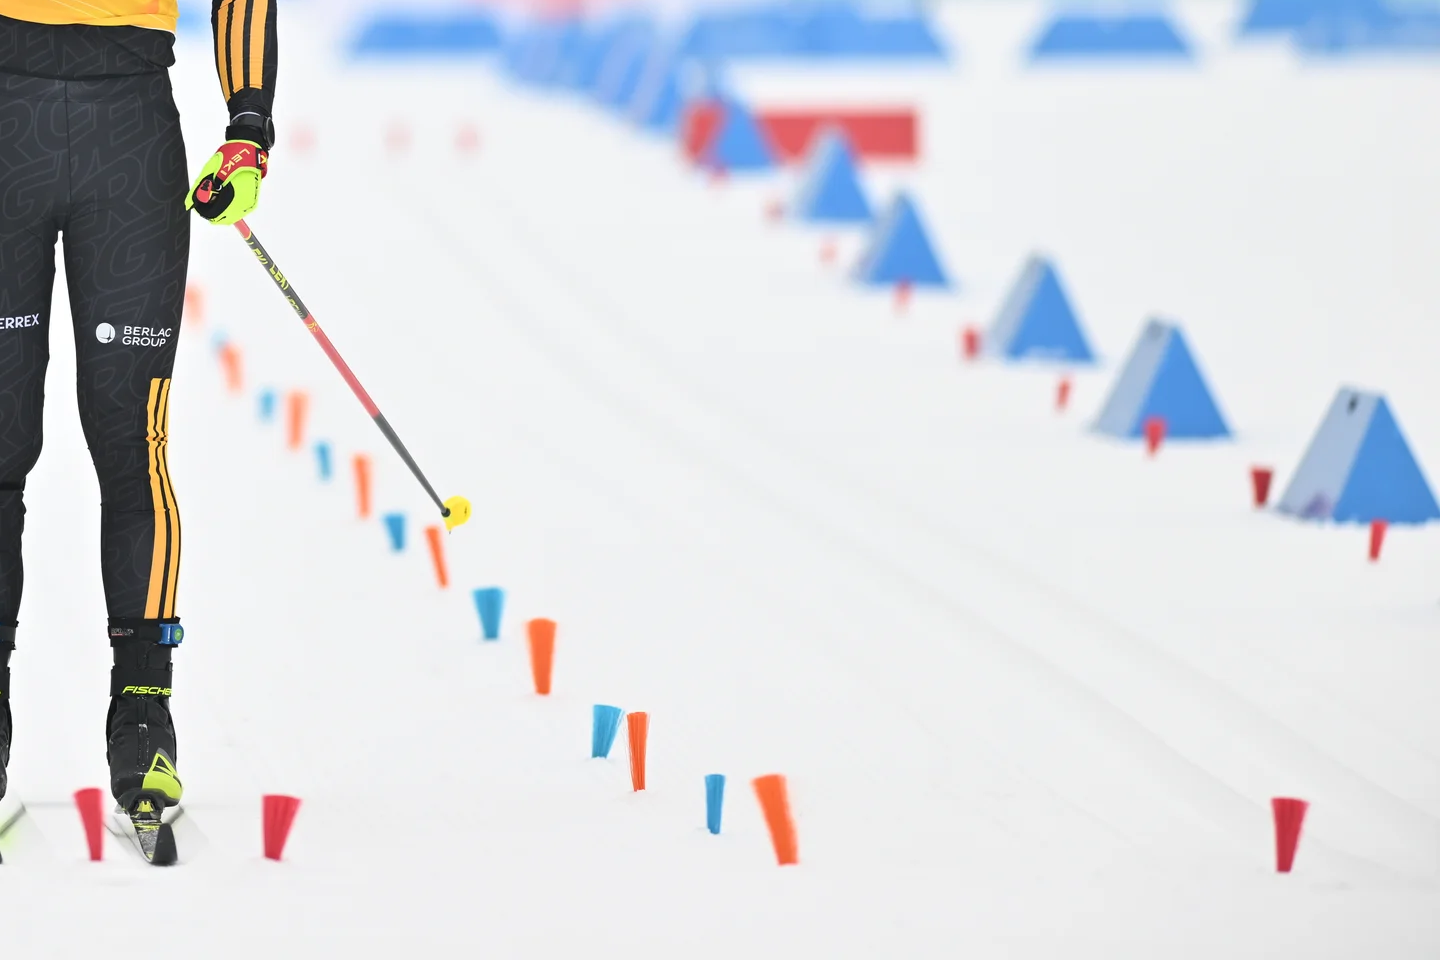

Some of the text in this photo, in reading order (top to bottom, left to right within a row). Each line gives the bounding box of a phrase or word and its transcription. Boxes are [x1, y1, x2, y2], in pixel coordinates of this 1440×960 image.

[220, 147, 251, 177] LEKI
[123, 325, 173, 338] BERLAC
[122, 336, 167, 348] GROUP
[122, 685, 173, 696] FISCHE
